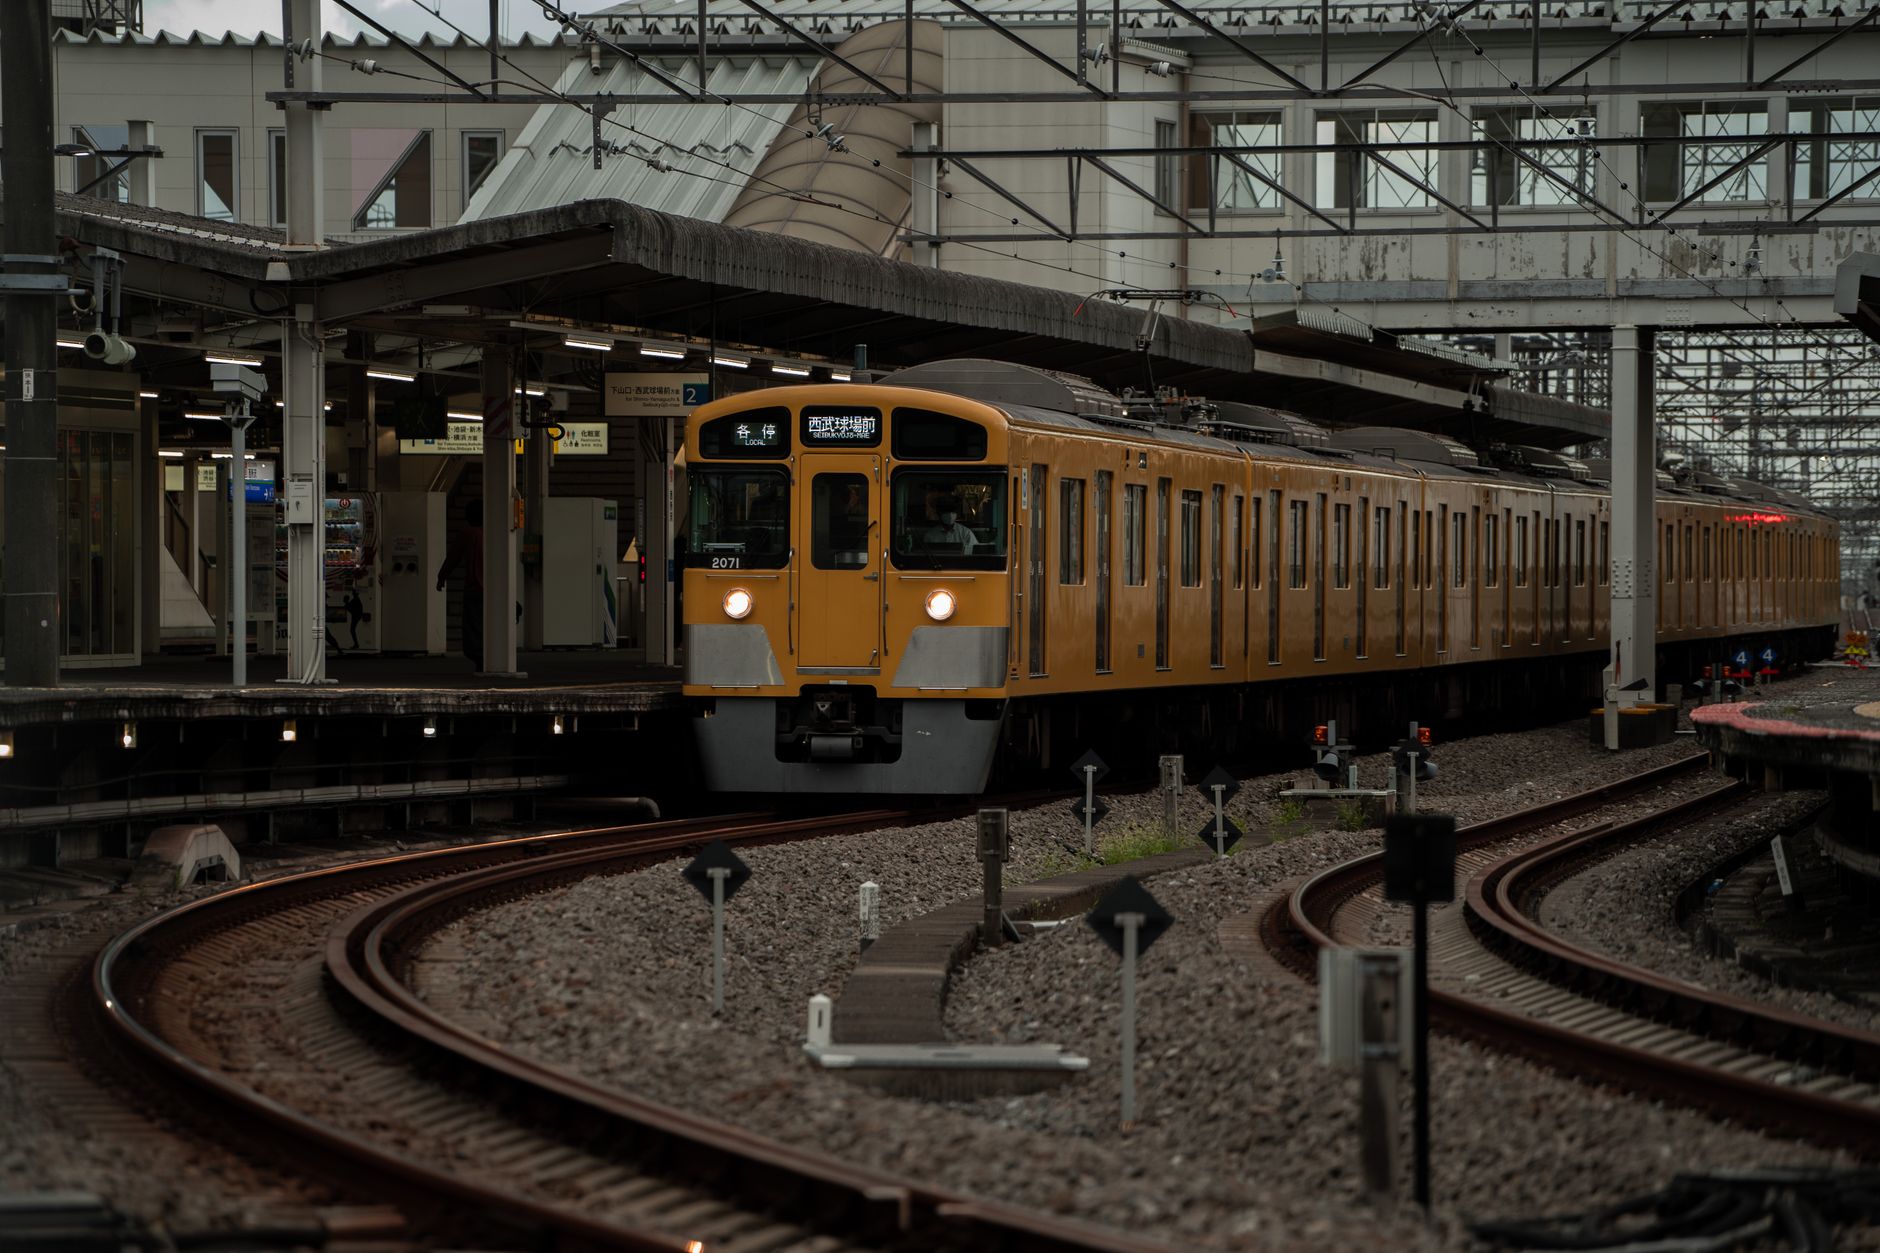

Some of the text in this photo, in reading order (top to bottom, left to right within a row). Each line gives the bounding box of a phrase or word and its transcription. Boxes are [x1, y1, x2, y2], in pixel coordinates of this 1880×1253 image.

[685, 387, 697, 404] 2
[807, 416, 876, 433] 西武球場前
[711, 556, 740, 569] 2071
[1736, 651, 1748, 665] 4
[1762, 648, 1773, 662] 4
